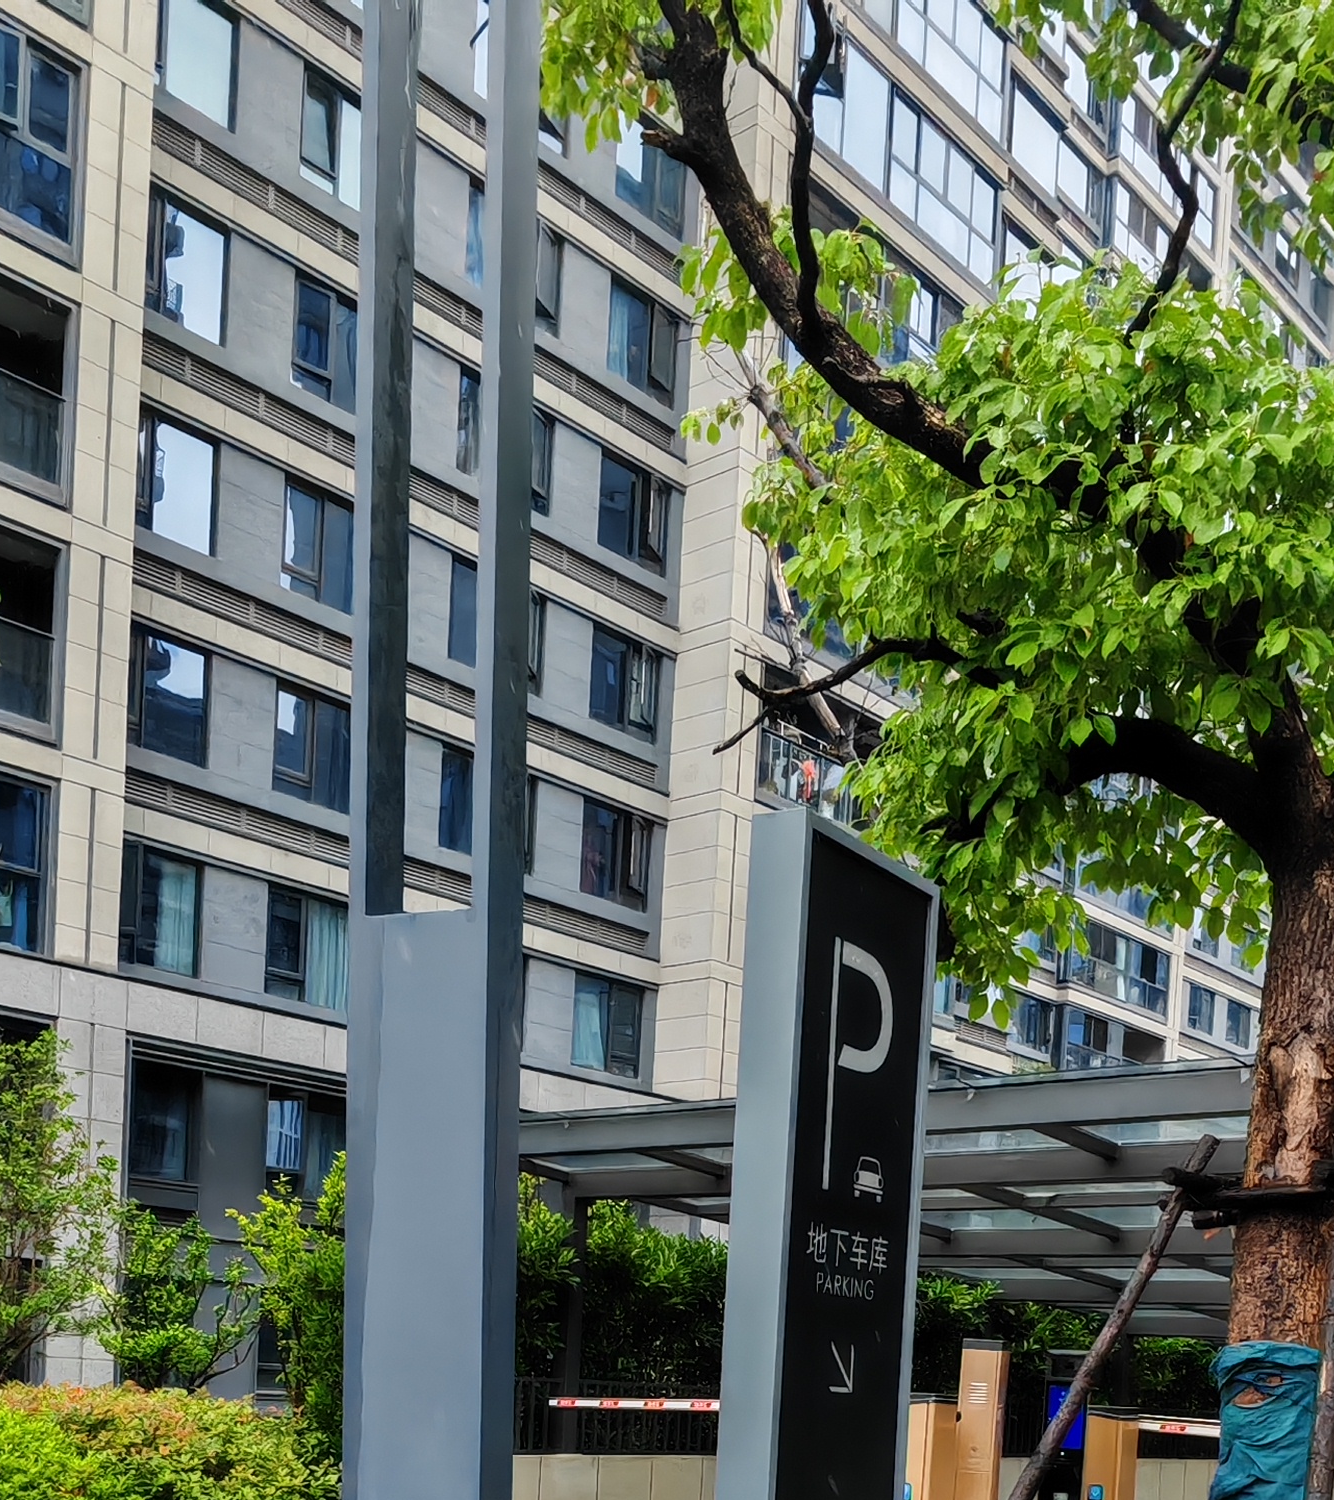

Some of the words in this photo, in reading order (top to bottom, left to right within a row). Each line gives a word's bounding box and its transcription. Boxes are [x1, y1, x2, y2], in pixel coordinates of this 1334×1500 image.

[822, 936, 894, 1190] P
[806, 1221, 889, 1275] 地下车库
[816, 1271, 875, 1300] PARKING
